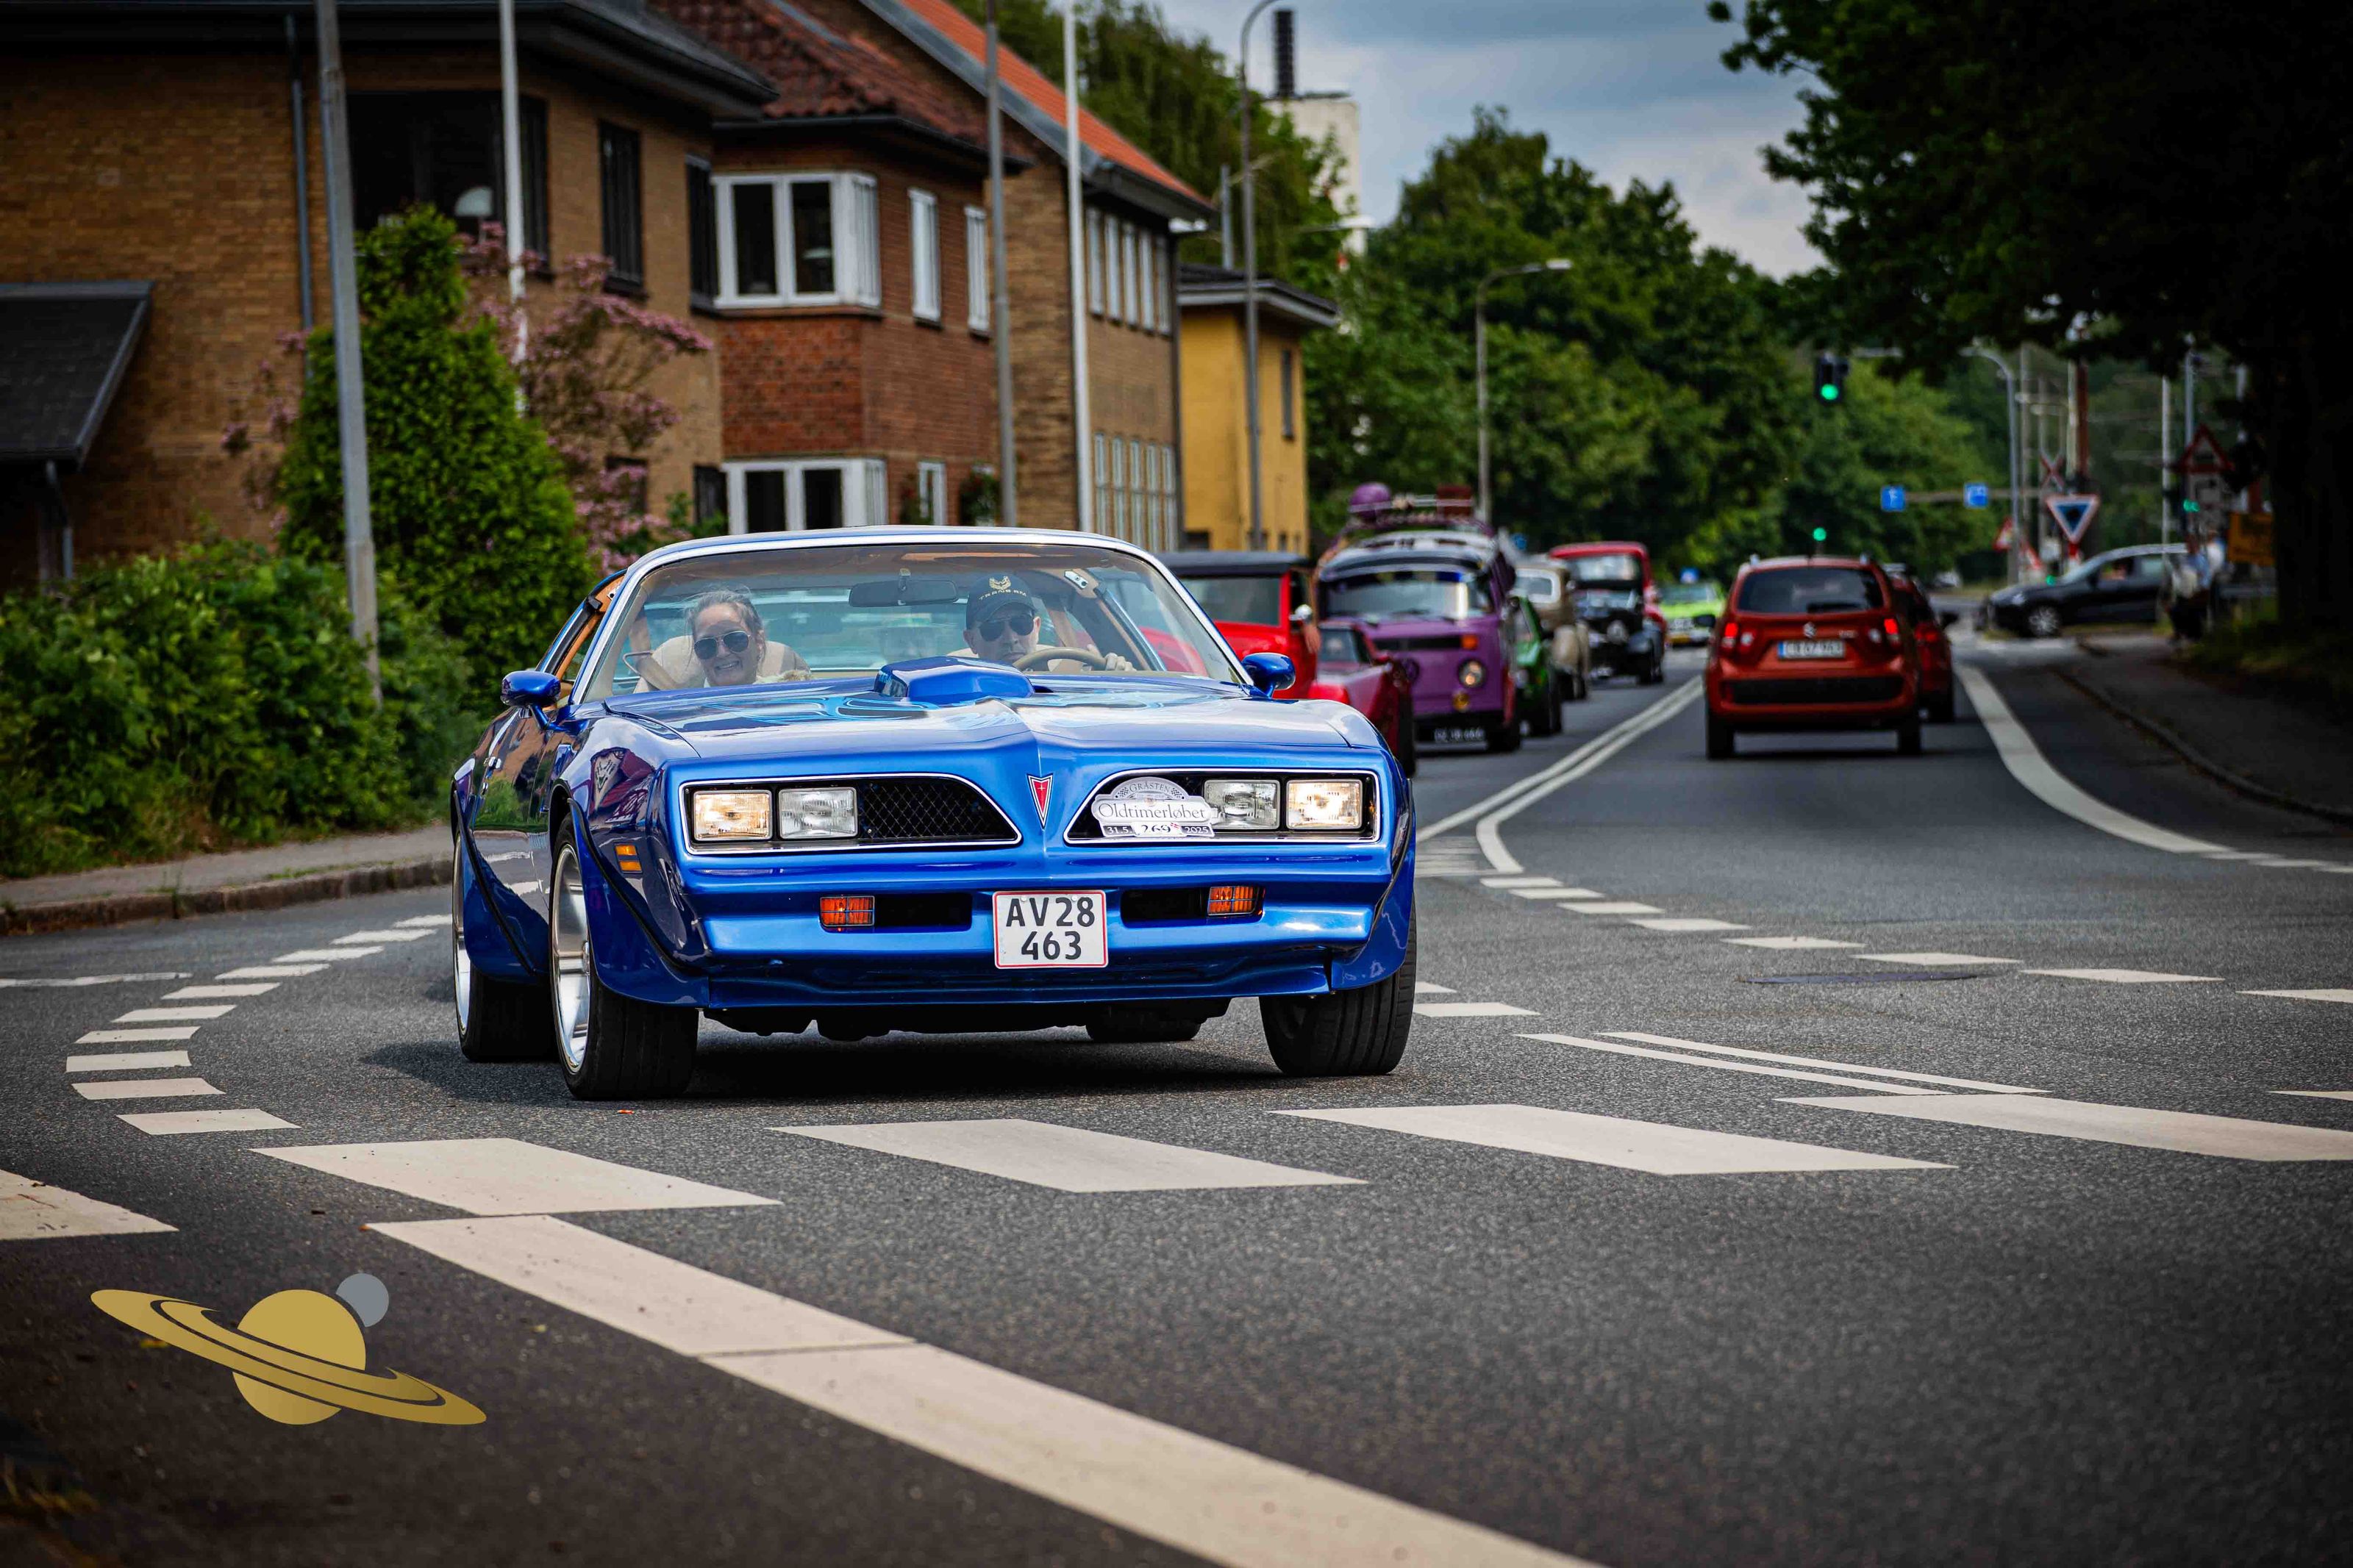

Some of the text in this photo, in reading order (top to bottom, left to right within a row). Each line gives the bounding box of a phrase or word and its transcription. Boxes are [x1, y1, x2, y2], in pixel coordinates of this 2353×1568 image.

[1129, 782, 1171, 792] GRÅSTEN
[1098, 803, 1205, 819] Oldtimerløbet
[1185, 826, 1209, 834] 2025
[1021, 931, 1082, 960] 463
